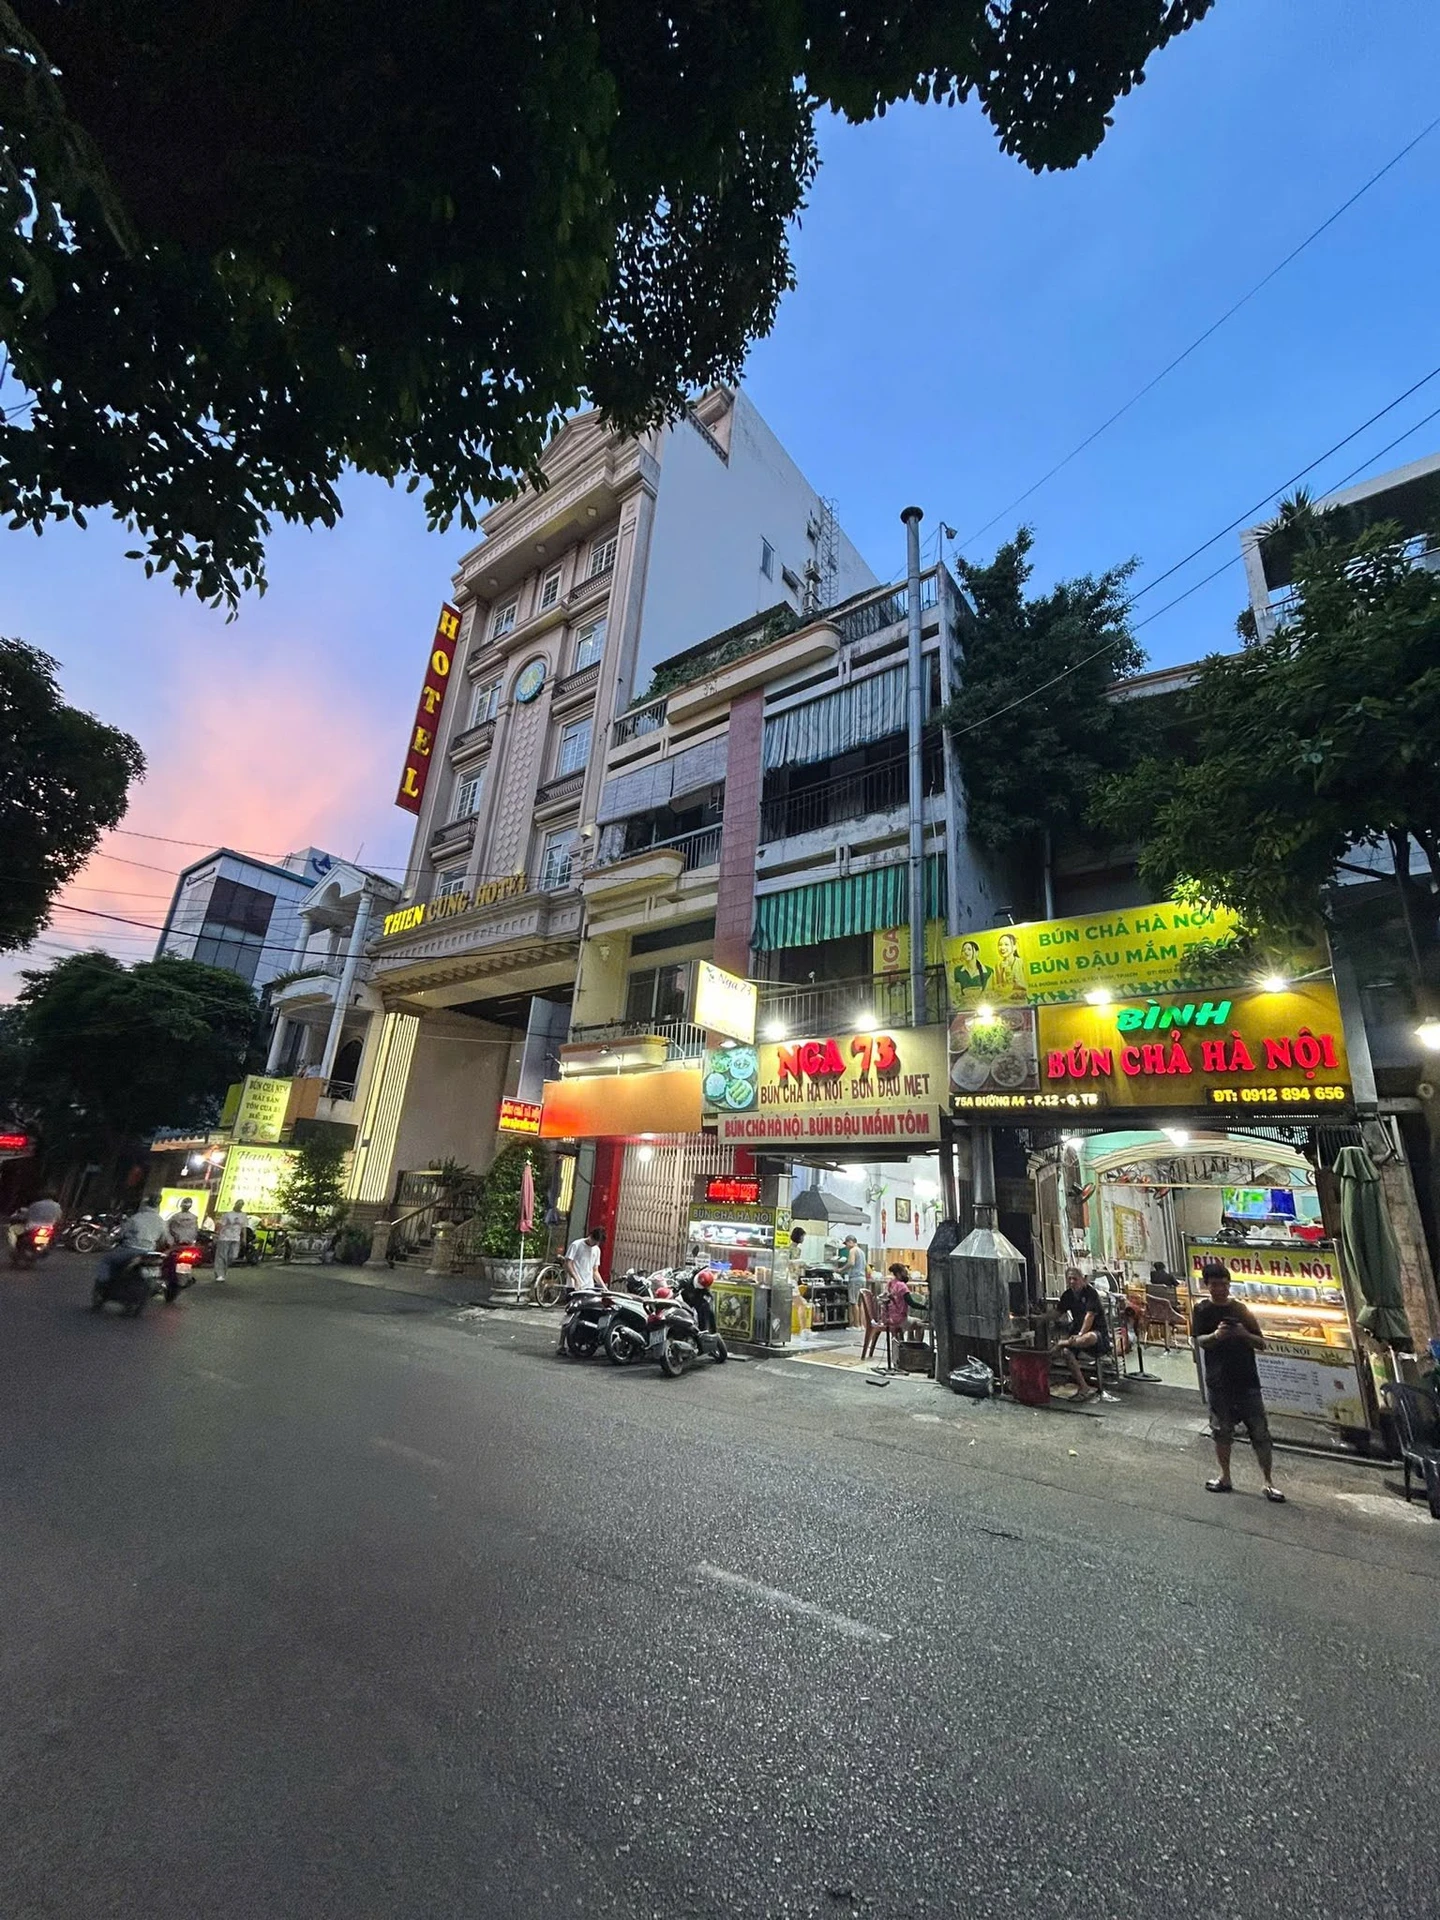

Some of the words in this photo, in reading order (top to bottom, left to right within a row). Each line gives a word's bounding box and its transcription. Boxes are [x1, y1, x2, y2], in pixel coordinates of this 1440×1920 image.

[401, 610, 459, 799] HOTEL
[426, 891, 470, 921] CUNG
[473, 872, 528, 907] HOTEL
[1039, 926, 1080, 947] BÚN
[1086, 917, 1130, 940] CHẢ
[1135, 912, 1168, 934] HÀ
[1173, 908, 1215, 931] NỘI
[1029, 956, 1070, 975] BÚN
[1076, 949, 1120, 971] ĐẬU
[1126, 940, 1178, 965] MẮM
[1116, 999, 1232, 1031] BÌNH
[778, 1037, 845, 1080] NGA
[851, 1035, 900, 1074] 73
[1048, 1041, 1112, 1078] BÚN
[1120, 1030, 1193, 1076] CHẢ
[1201, 1030, 1256, 1073] HÀ
[1262, 1027, 1340, 1079] NỘI
[761, 1080, 780, 1105] BÚN
[904, 1073, 930, 1100] MẸT
[954, 1096, 973, 1107] 75A
[1213, 1089, 1238, 1102] ĐT:
[1241, 1088, 1278, 1102] 0912
[1281, 1087, 1311, 1101] 894
[1314, 1086, 1345, 1100] 656
[725, 1116, 745, 1137] BÚN
[767, 1114, 782, 1137] HÀ
[834, 1111, 860, 1139] ĐẬU
[862, 1108, 896, 1135] MẮM
[897, 1108, 930, 1135] TÔM
[693, 1206, 711, 1219] BÚN
[1230, 1252, 1265, 1275] CHẢ
[1269, 1256, 1295, 1277] HÀ
[1299, 1258, 1333, 1283] NỘI
